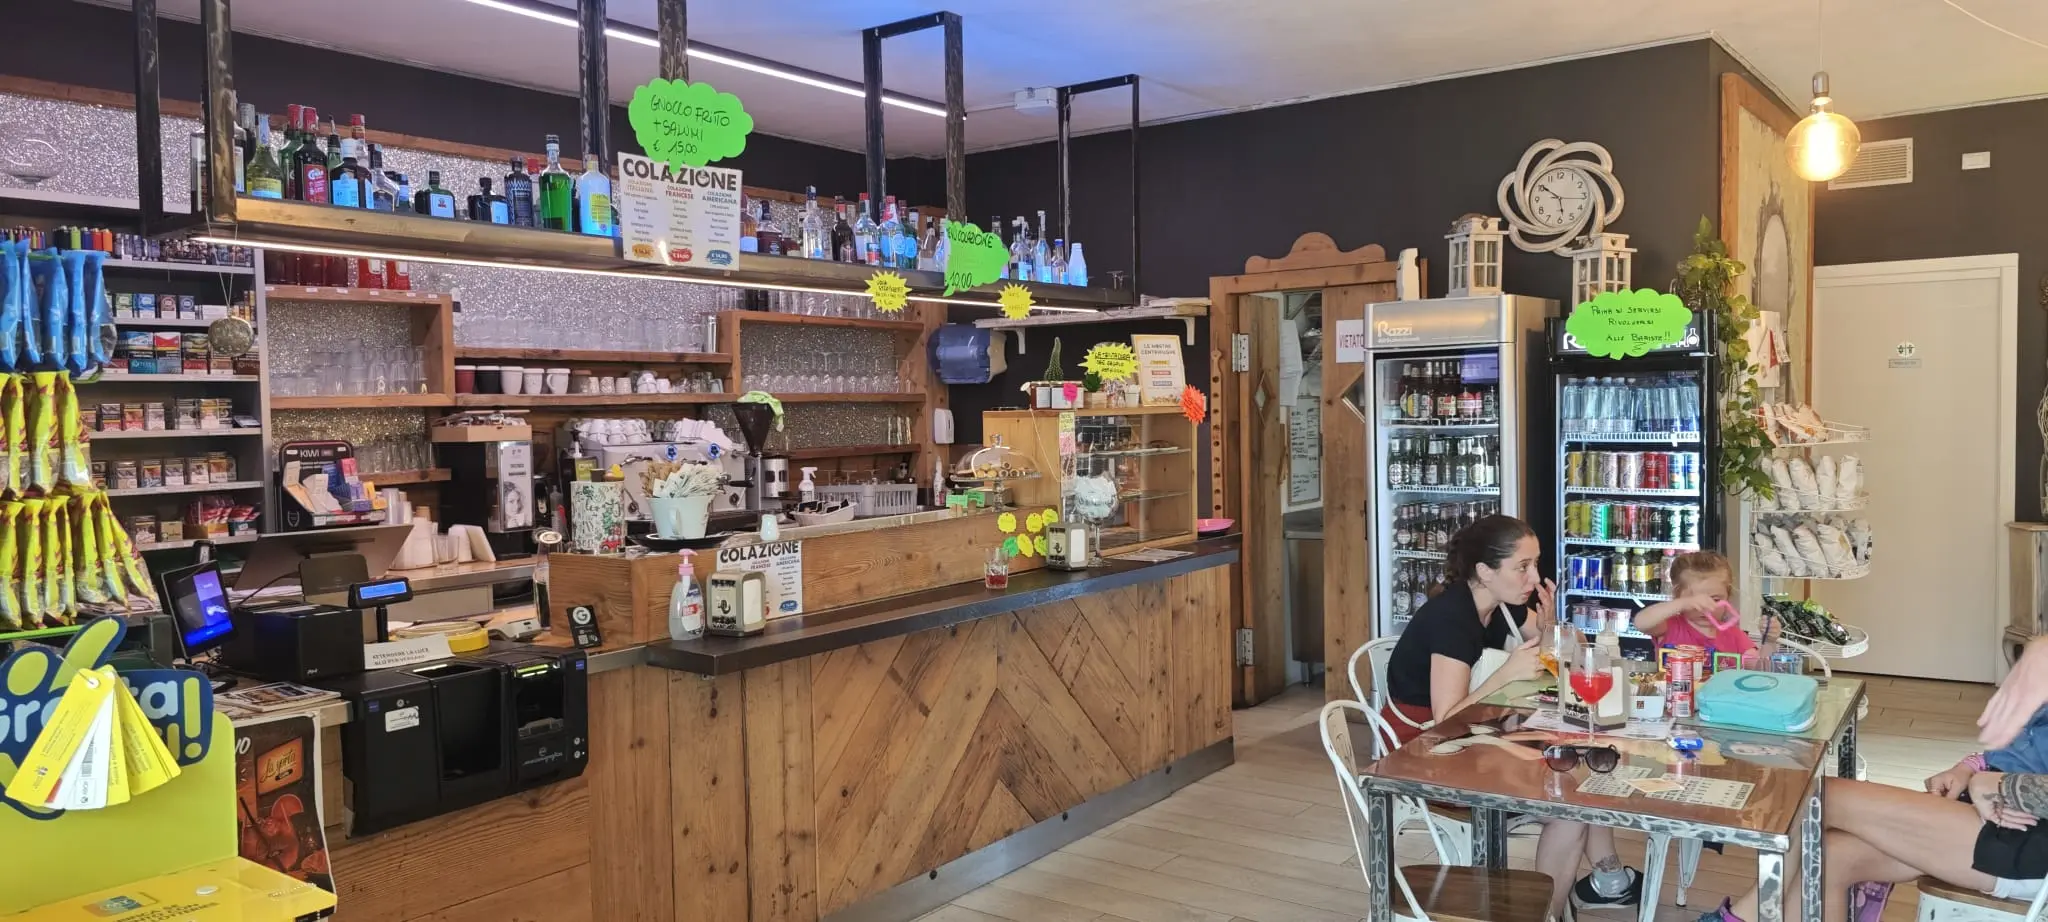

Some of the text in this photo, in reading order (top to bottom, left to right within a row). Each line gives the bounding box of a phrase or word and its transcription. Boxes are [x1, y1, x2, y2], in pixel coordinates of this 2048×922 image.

[651, 95, 692, 116] GNOCCO
[623, 158, 737, 191] COLAZIONE
[1557, 171, 1565, 180] 12
[1577, 181, 1584, 189] 2
[1538, 206, 1545, 215] 8
[1556, 217, 1563, 225] 6
[1569, 212, 1575, 220] 5
[1377, 320, 1413, 337] Razzi
[300, 448, 320, 458] KIWI
[720, 541, 799, 563] COLAZIONE
